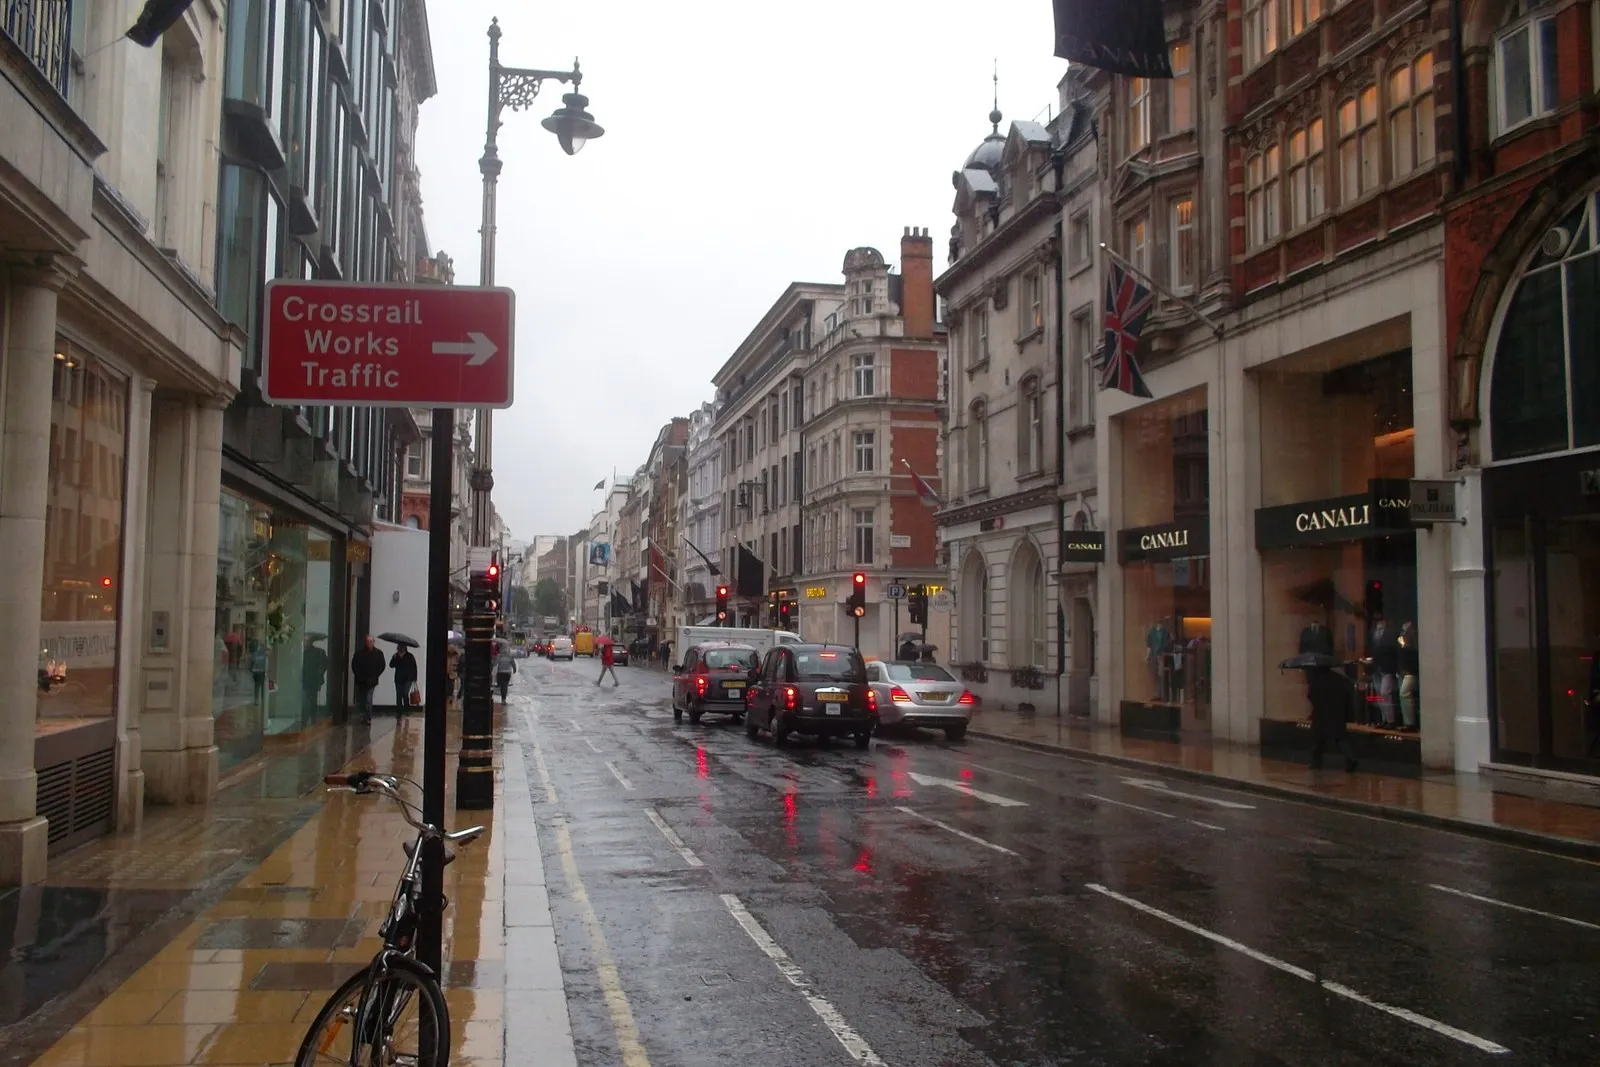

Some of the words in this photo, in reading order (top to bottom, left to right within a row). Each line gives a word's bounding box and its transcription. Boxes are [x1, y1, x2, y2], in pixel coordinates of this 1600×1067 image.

[282, 296, 423, 325] Crossrail
[304, 329, 400, 356] Works
[301, 361, 400, 388] Traffic
[1296, 504, 1370, 533] CANALI
[1067, 542, 1103, 551] CANALI
[1140, 529, 1189, 550] CANALI
